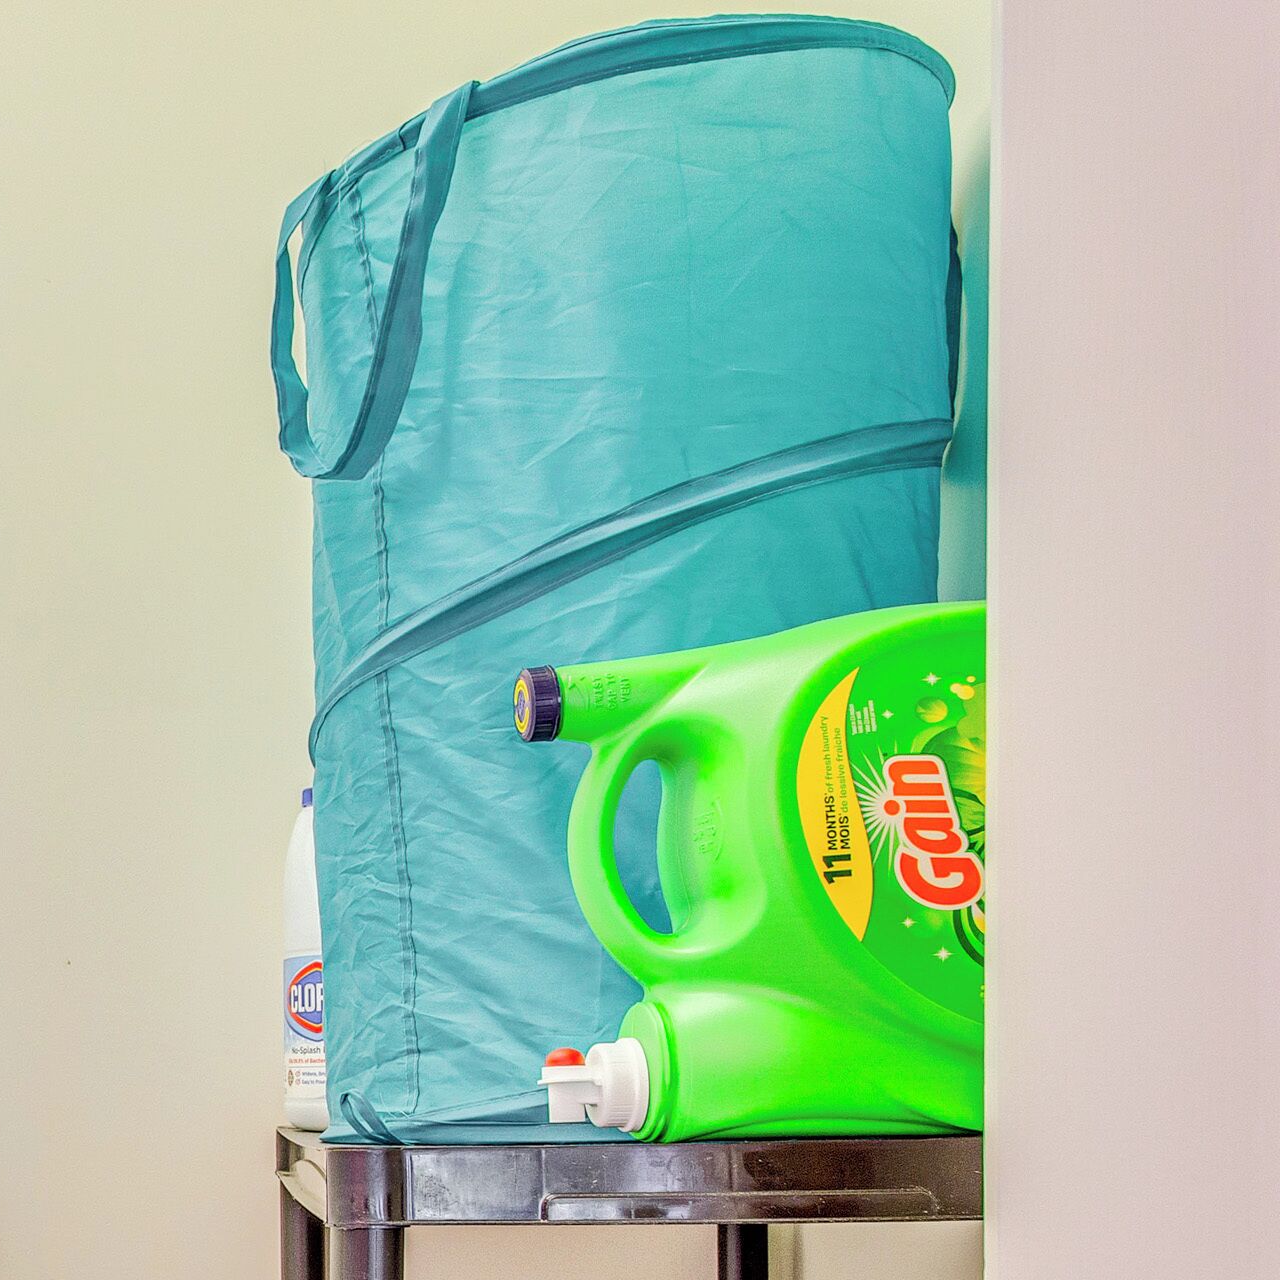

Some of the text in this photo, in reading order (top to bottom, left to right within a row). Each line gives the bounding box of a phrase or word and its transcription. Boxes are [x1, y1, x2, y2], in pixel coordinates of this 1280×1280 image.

[819, 716, 838, 850] MONTHS of fresh laundry
[837, 764, 848, 798] lessive
[839, 800, 849, 812] de
[838, 816, 851, 850] MOIS
[885, 758, 983, 908] Gain
[823, 853, 852, 884] 11
